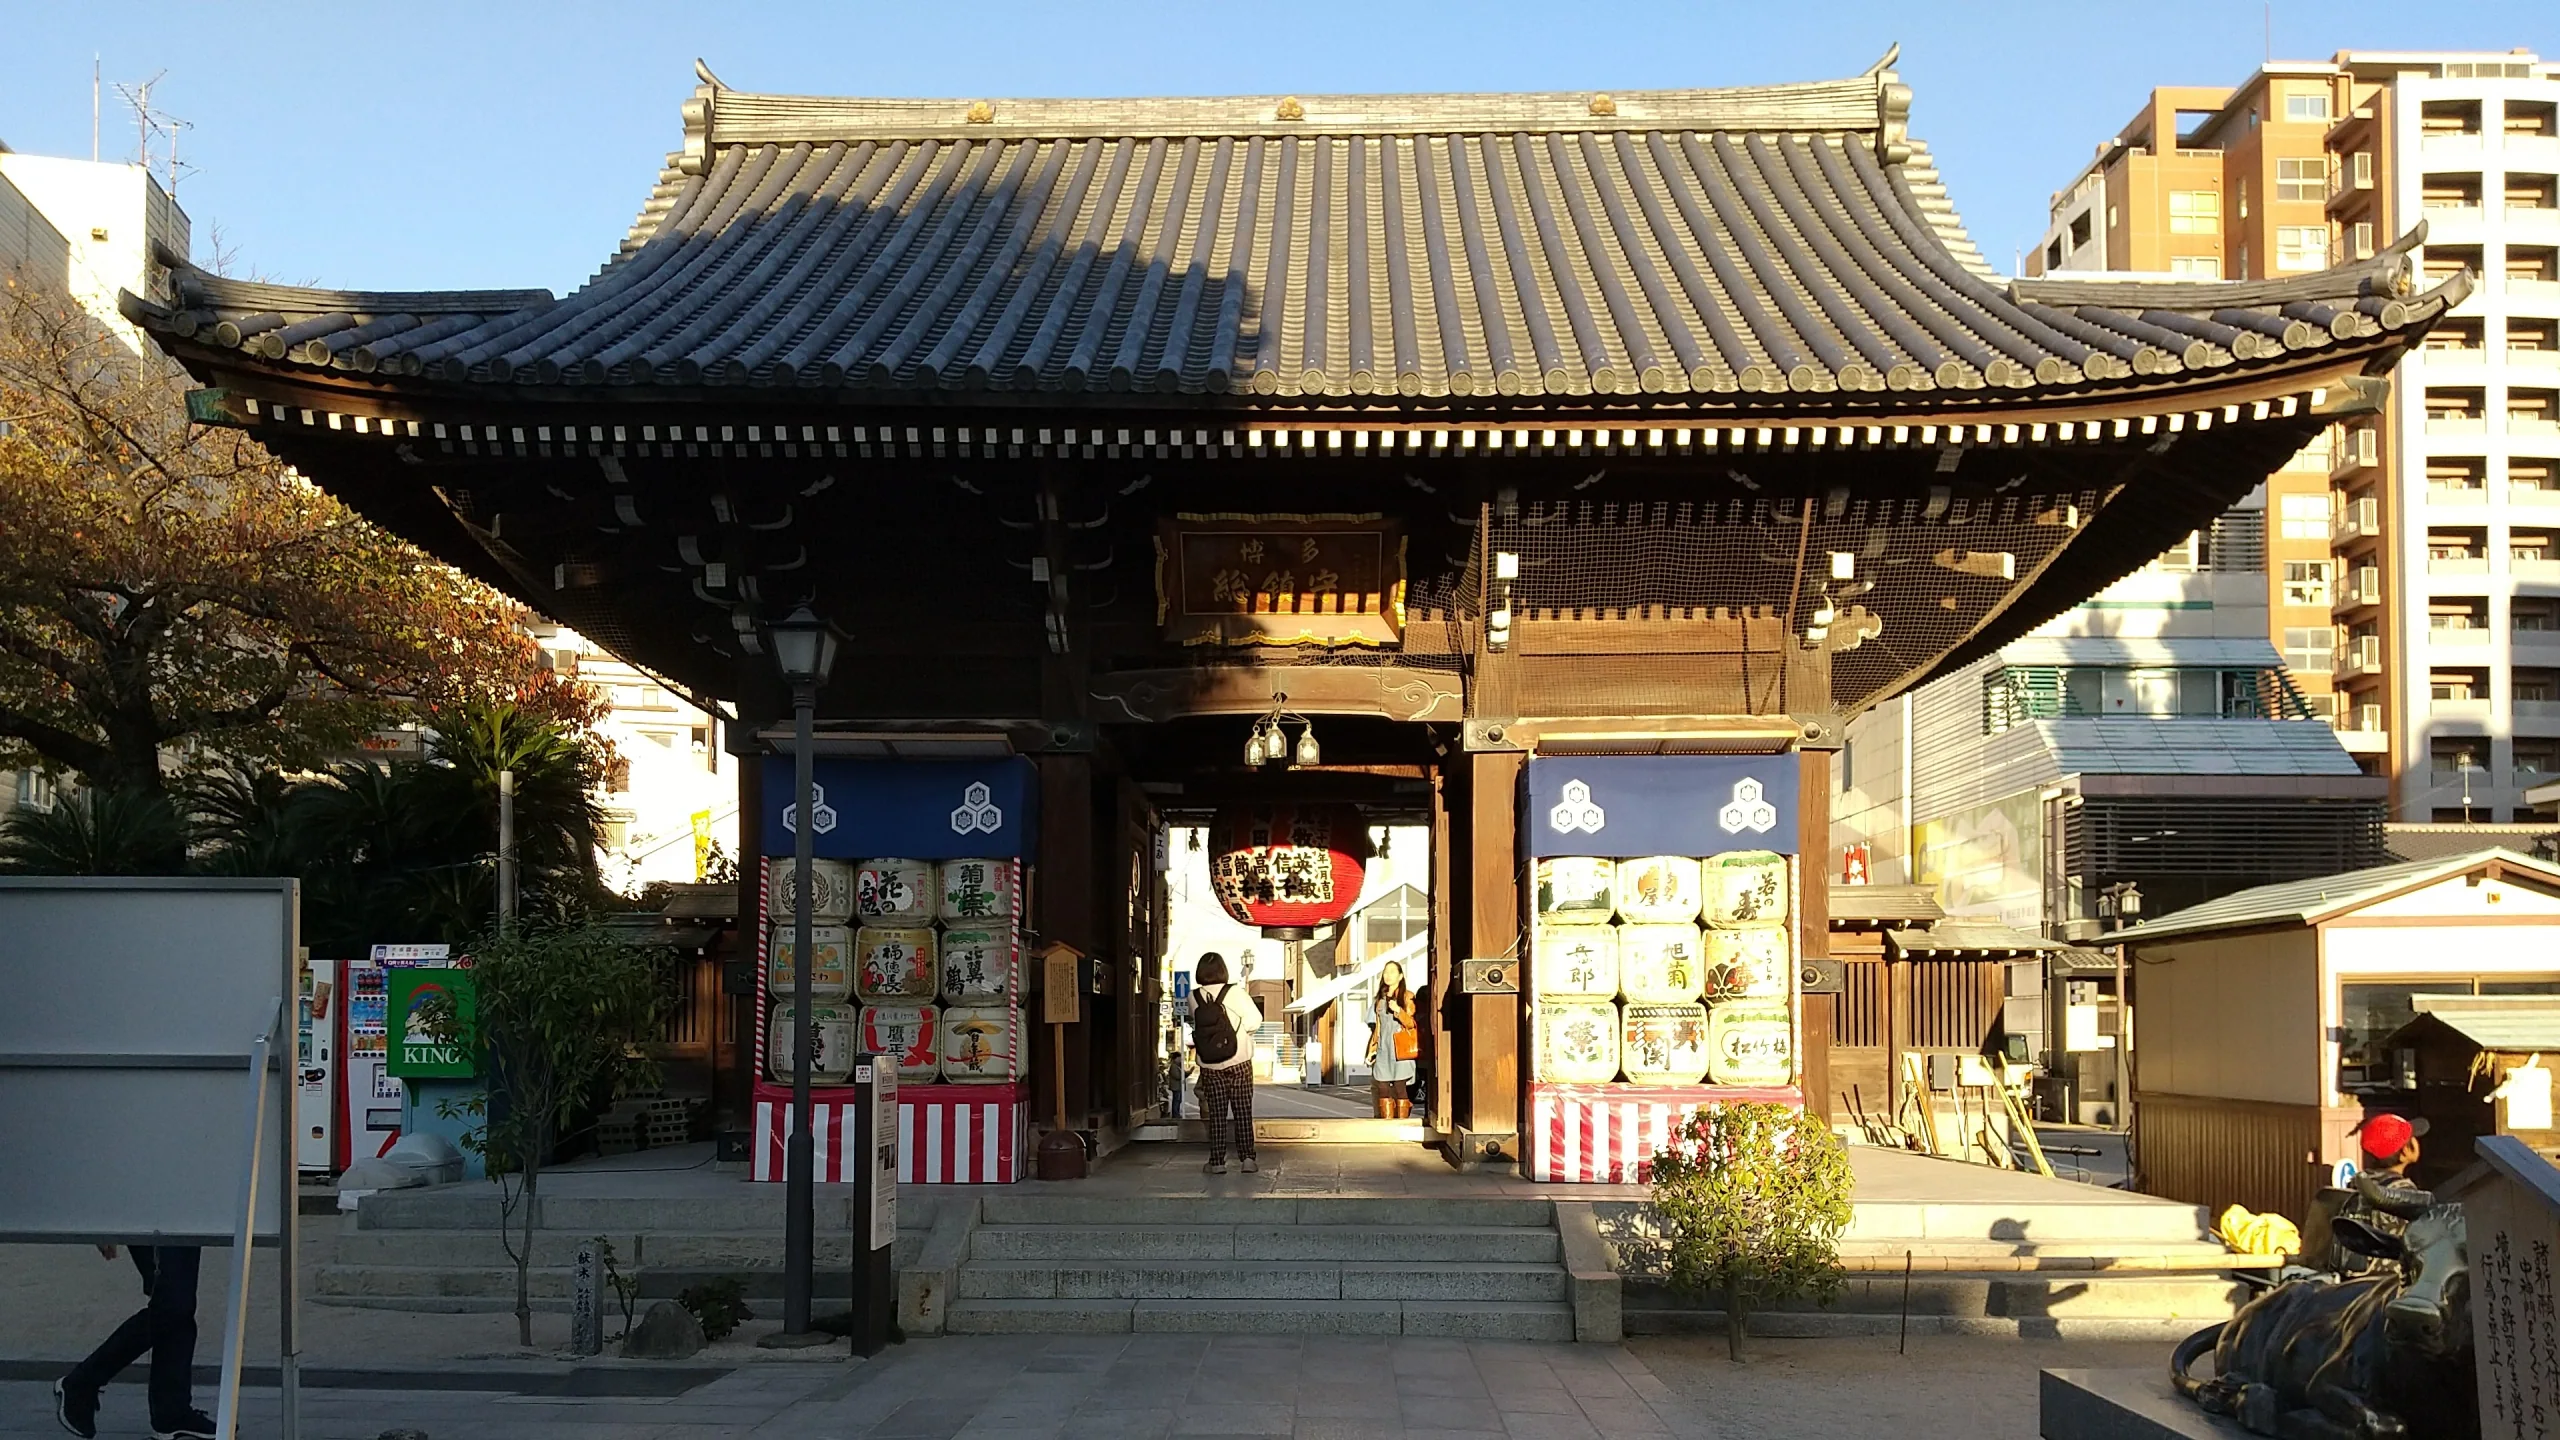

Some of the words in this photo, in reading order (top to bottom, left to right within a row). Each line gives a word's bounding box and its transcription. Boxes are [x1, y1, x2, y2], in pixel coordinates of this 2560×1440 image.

[1240, 537, 1320, 564] 博多
[1211, 568, 1340, 605] 総鎮守
[959, 863, 986, 917] 菊正宗
[1234, 854, 1255, 900] 節子
[1273, 852, 1299, 899] 信子
[782, 971, 829, 982] いさわ
[882, 943, 904, 994] 福徳長
[1662, 942, 1690, 990] 旭菊
[1765, 948, 1773, 981] やつしか
[403, 1047, 461, 1065] KING
[1731, 1036, 1788, 1058] 松竹梅
